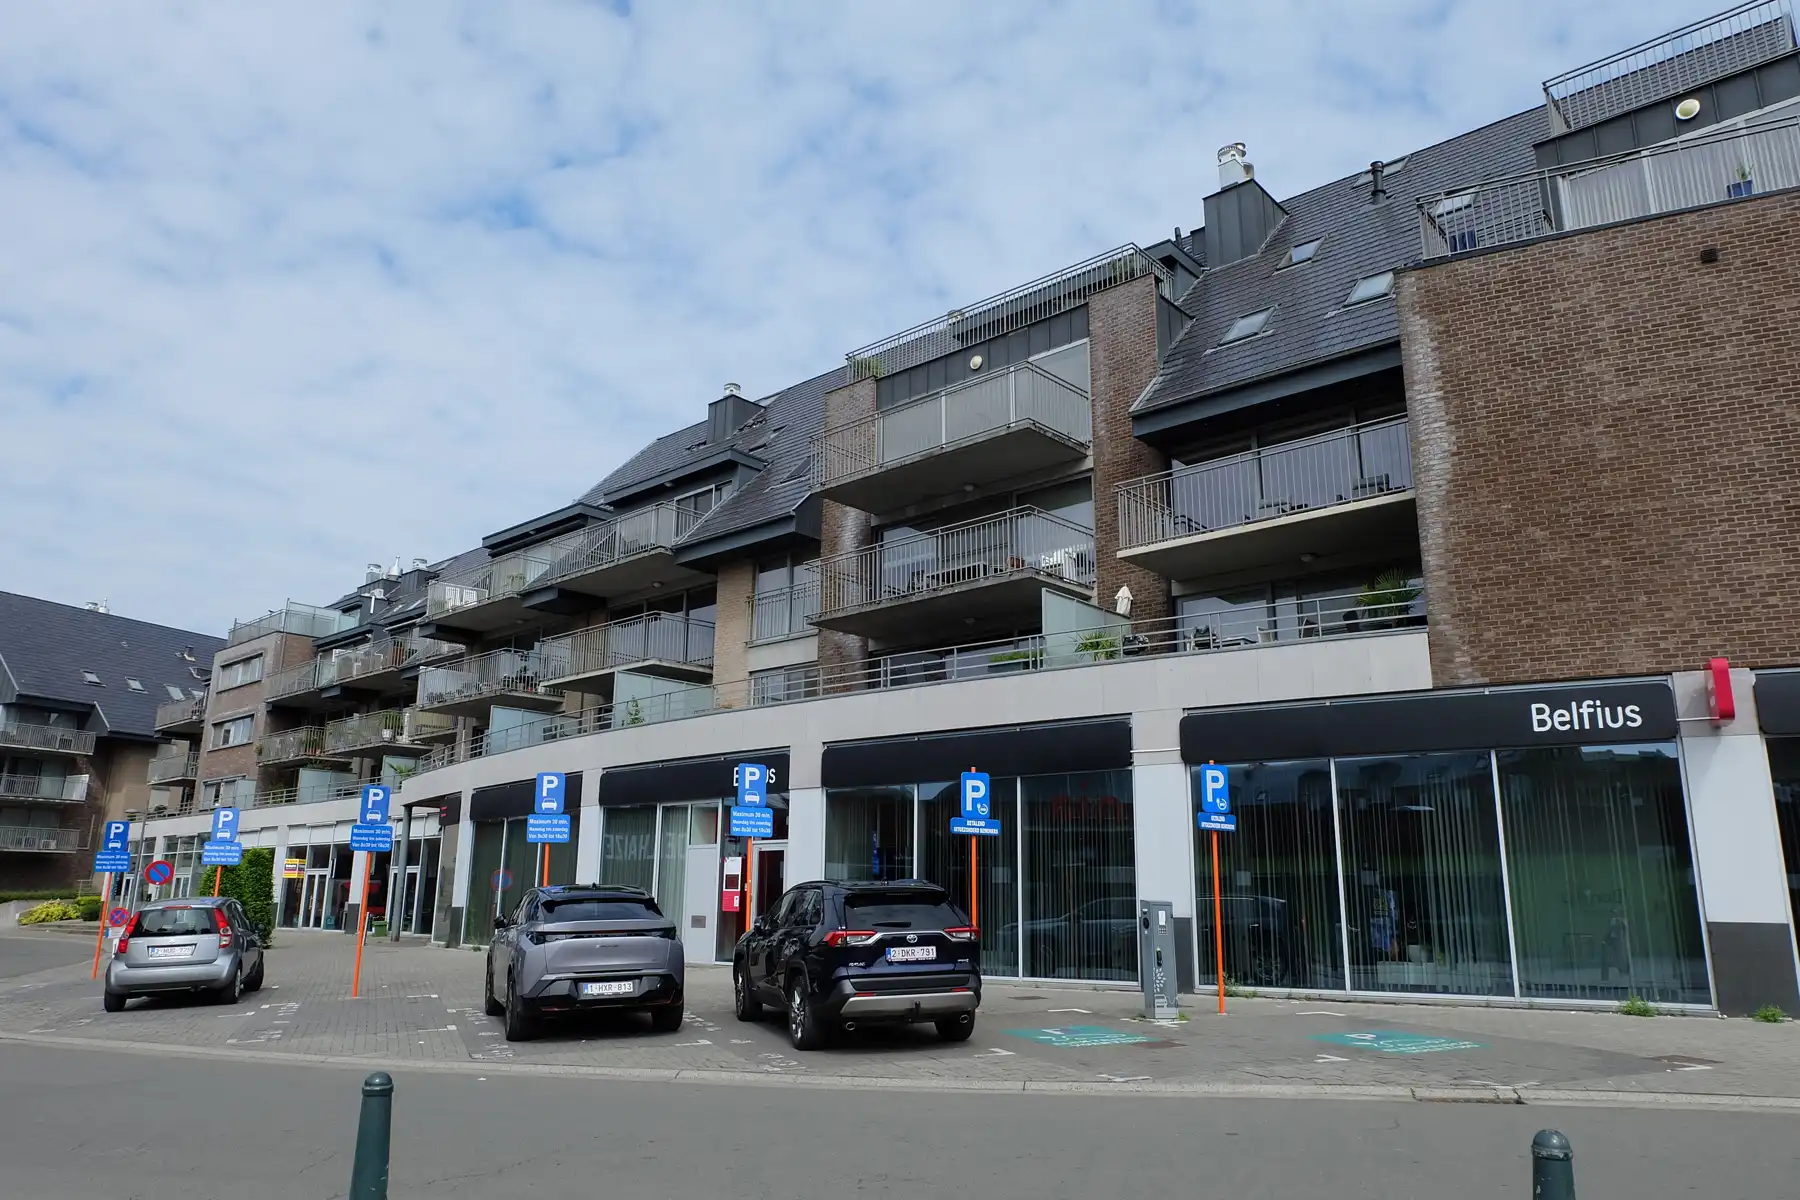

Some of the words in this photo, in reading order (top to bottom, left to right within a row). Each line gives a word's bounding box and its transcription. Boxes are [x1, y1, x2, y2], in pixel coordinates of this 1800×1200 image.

[1531, 700, 1642, 732] Belfius
[542, 775, 558, 797] P
[745, 767, 760, 789] P
[1206, 770, 1225, 802] P
[368, 789, 383, 808] P
[966, 780, 985, 811] P
[218, 811, 233, 828] P
[110, 823, 124, 839] P
[892, 948, 934, 958] 2-DKR-791
[590, 982, 632, 992] 1-HXR-813
